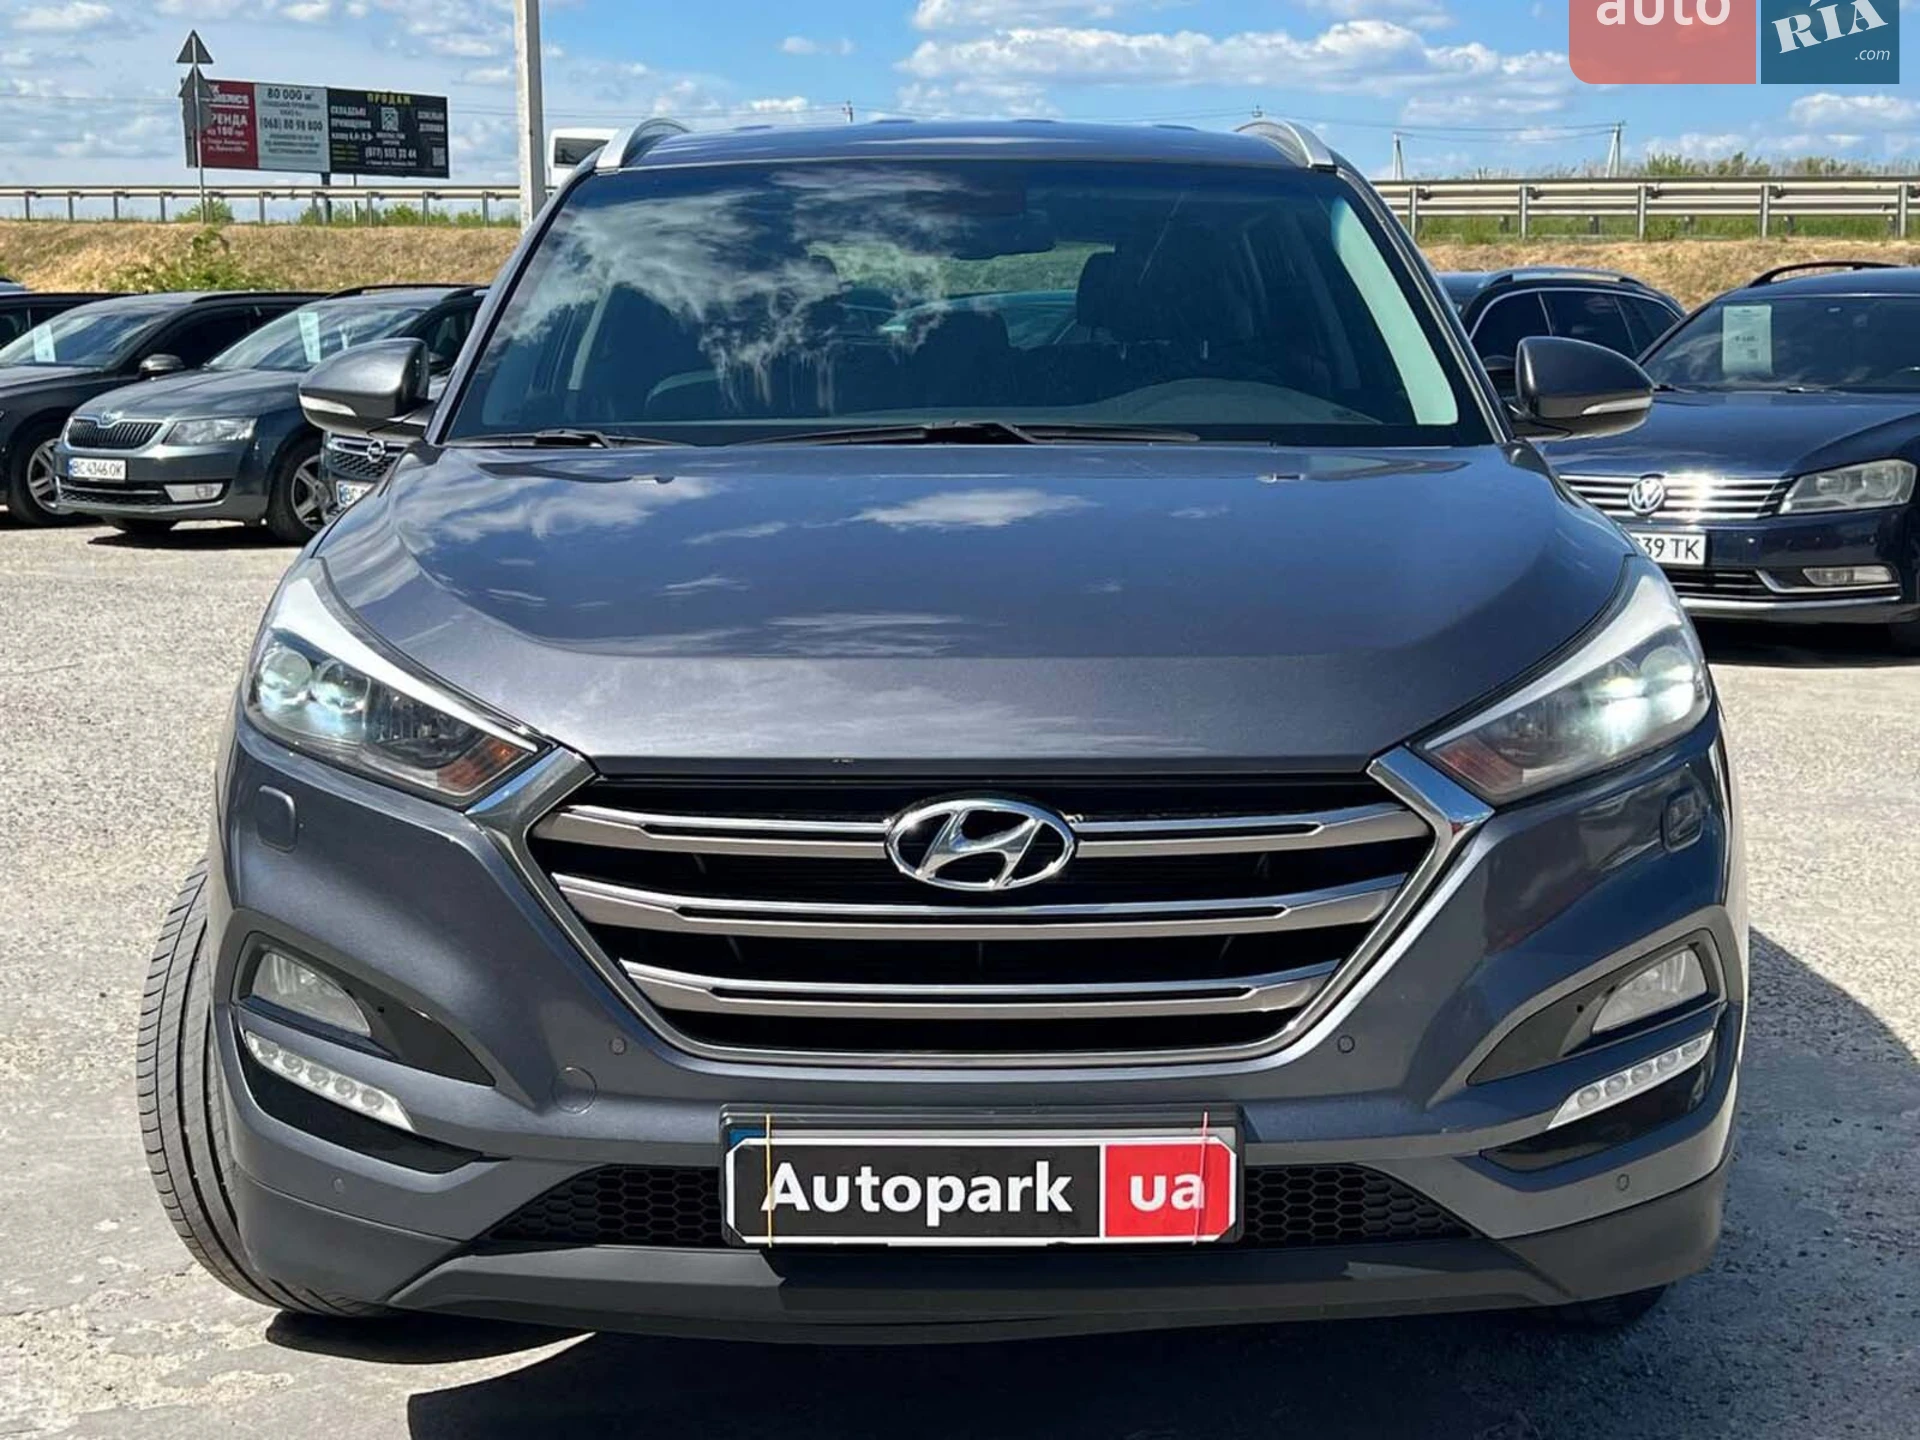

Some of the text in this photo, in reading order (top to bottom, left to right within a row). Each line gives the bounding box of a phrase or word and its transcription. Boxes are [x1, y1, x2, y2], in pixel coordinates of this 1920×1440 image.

[267, 87, 281, 99] 80
[282, 89, 303, 101] 000
[210, 113, 249, 127] РЕНДА
[1634, 536, 1700, 560] 39 TK
[760, 1161, 1206, 1227] Autopark ua
